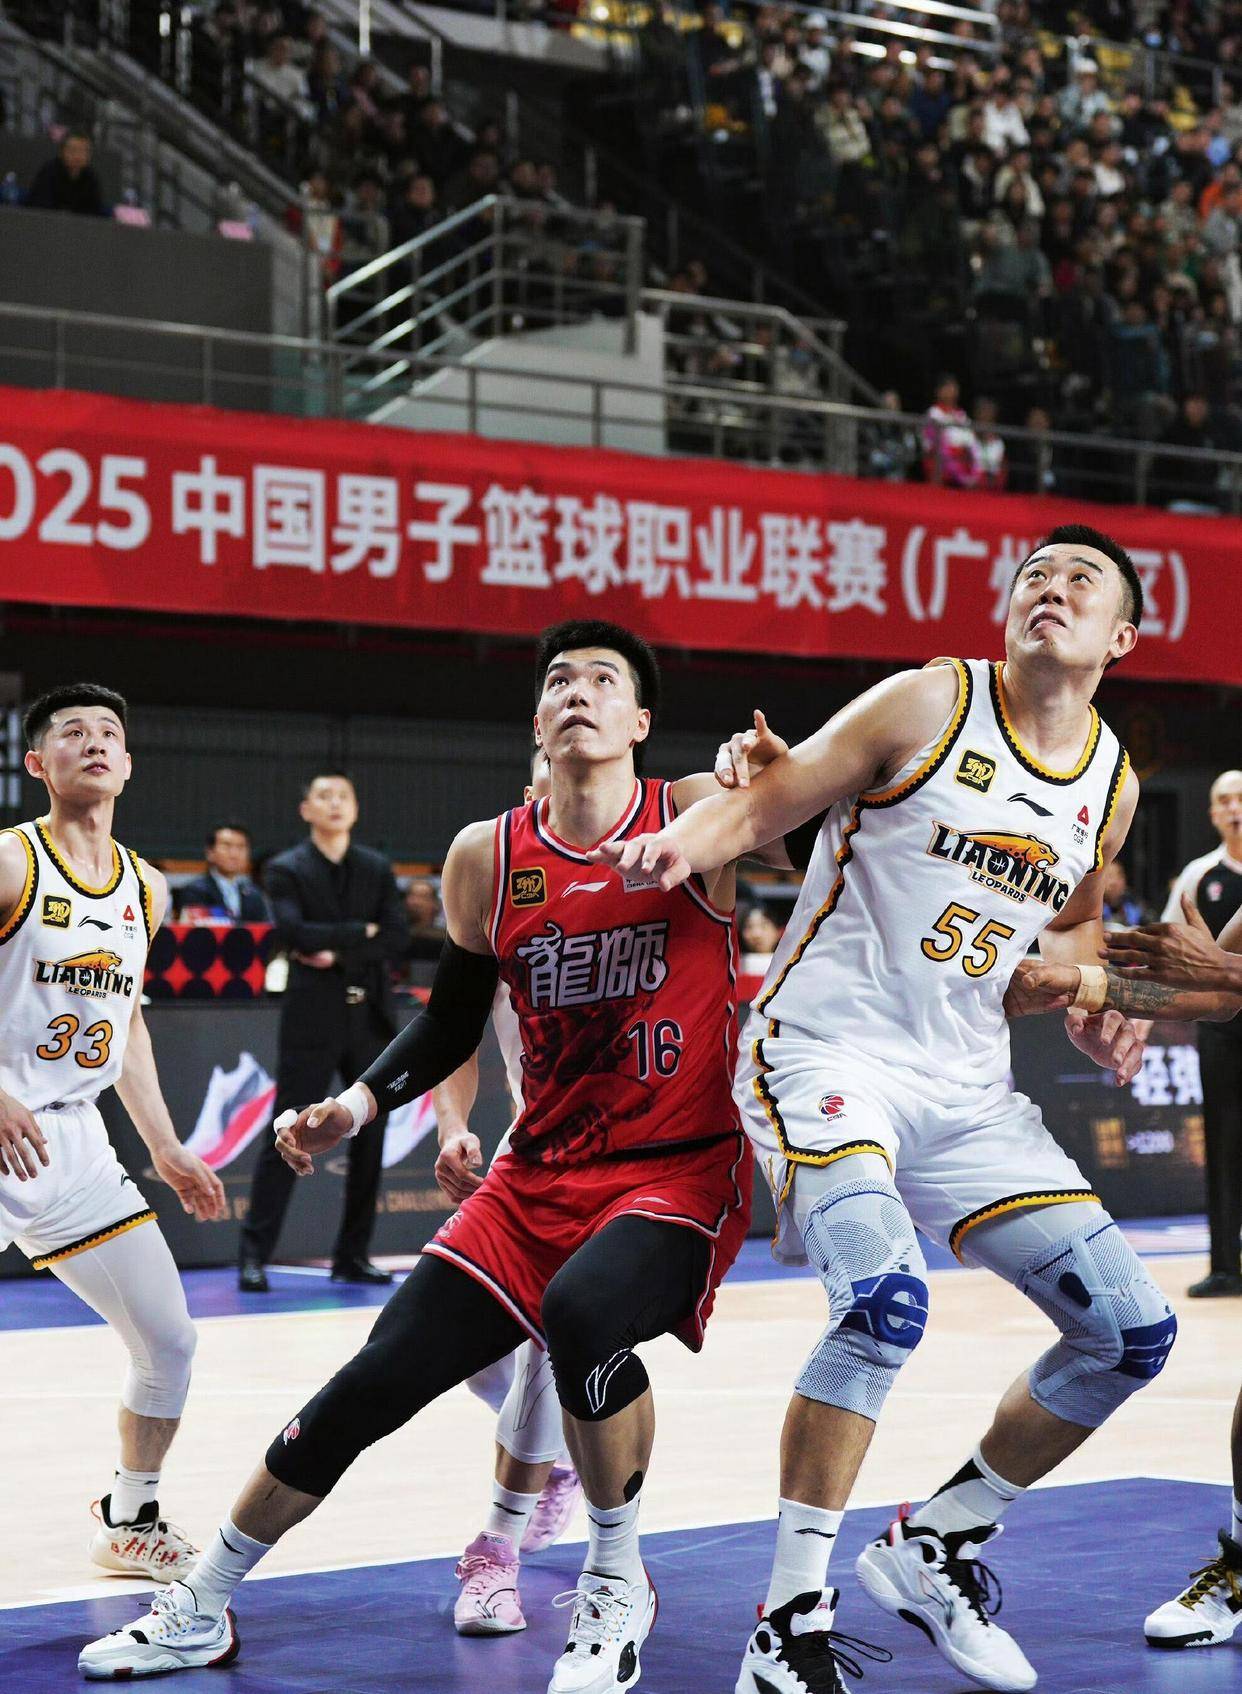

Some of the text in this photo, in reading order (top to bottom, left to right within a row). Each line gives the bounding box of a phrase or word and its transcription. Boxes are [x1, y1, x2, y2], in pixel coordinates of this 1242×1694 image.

[930, 824, 1070, 913] LIAONING
[971, 871, 1027, 903] LEOPARDS
[920, 901, 1017, 977] 55
[35, 960, 134, 997] LIAONING
[68, 986, 108, 999] LEOPARDS
[36, 1013, 114, 1068] 33
[626, 1018, 684, 1081] 16
